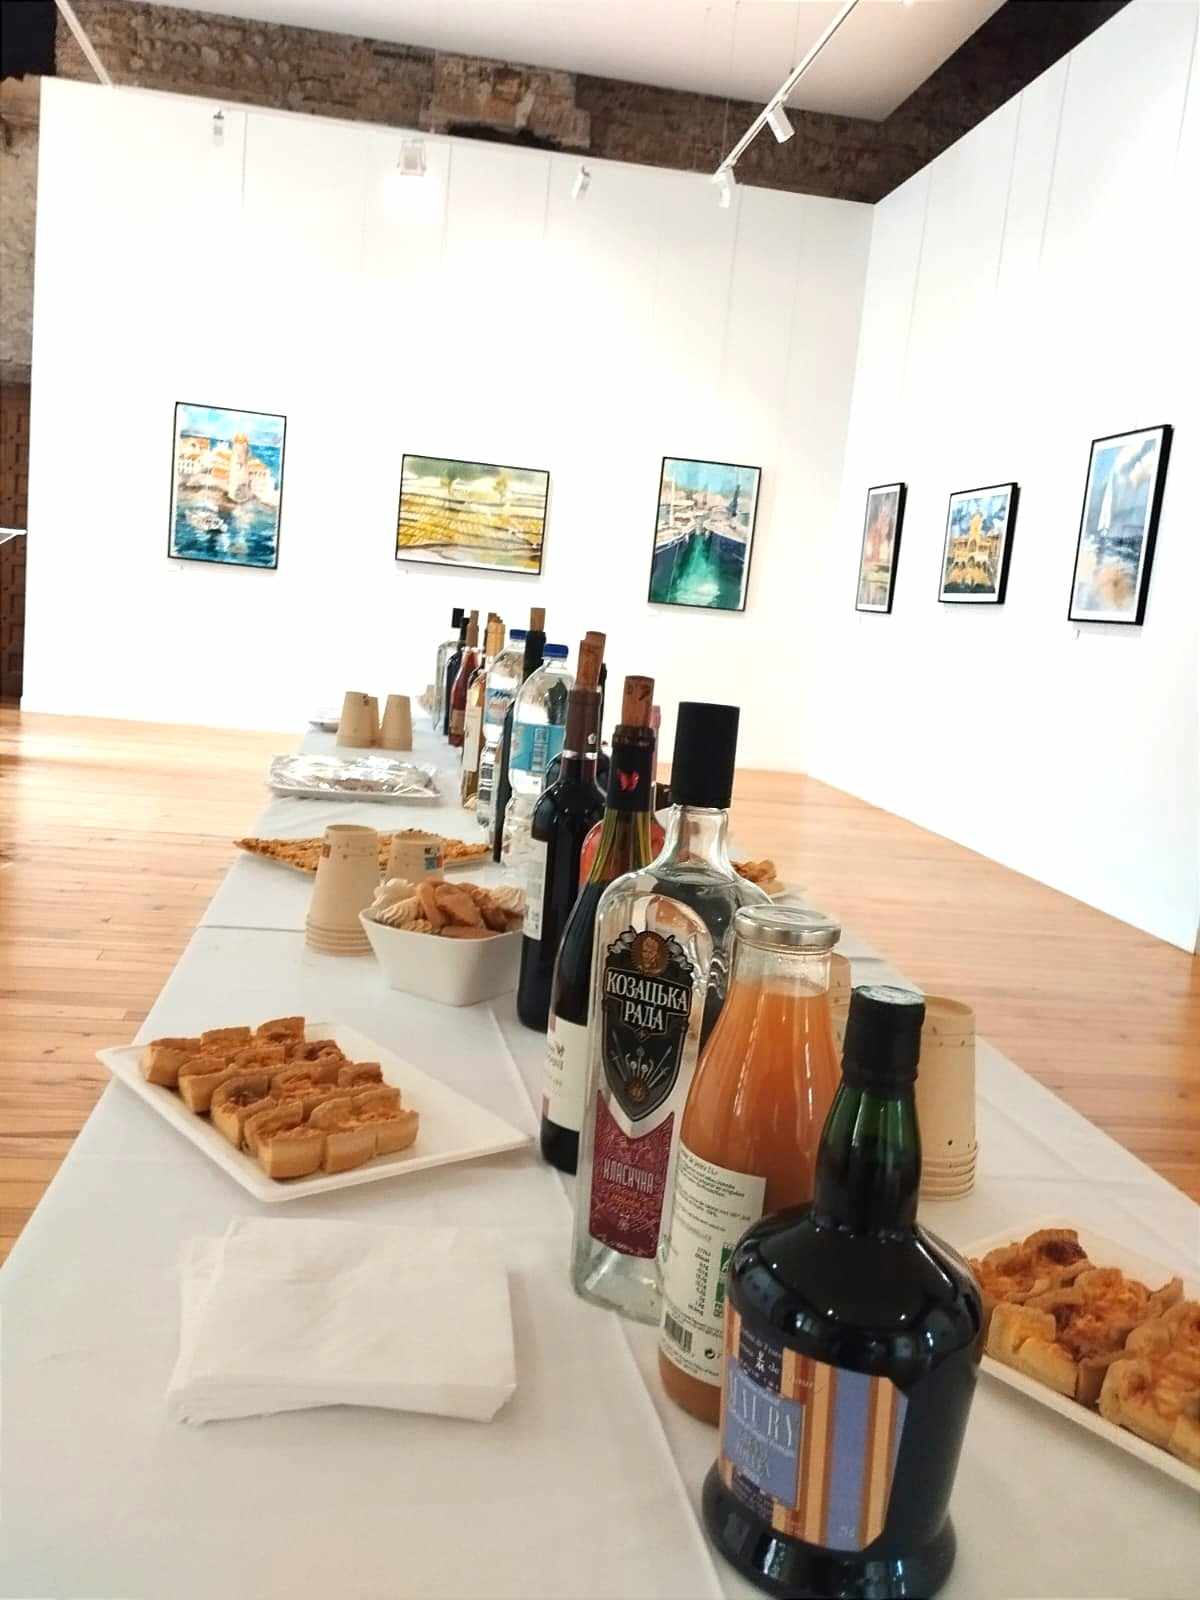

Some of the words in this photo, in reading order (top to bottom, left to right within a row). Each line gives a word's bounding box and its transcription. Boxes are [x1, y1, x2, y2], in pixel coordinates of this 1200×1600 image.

[606, 971, 688, 1011] КОЗАЦЬКА
[623, 1001, 664, 1031] РАДА
[603, 1157, 655, 1195] КЛАСИЧНА
